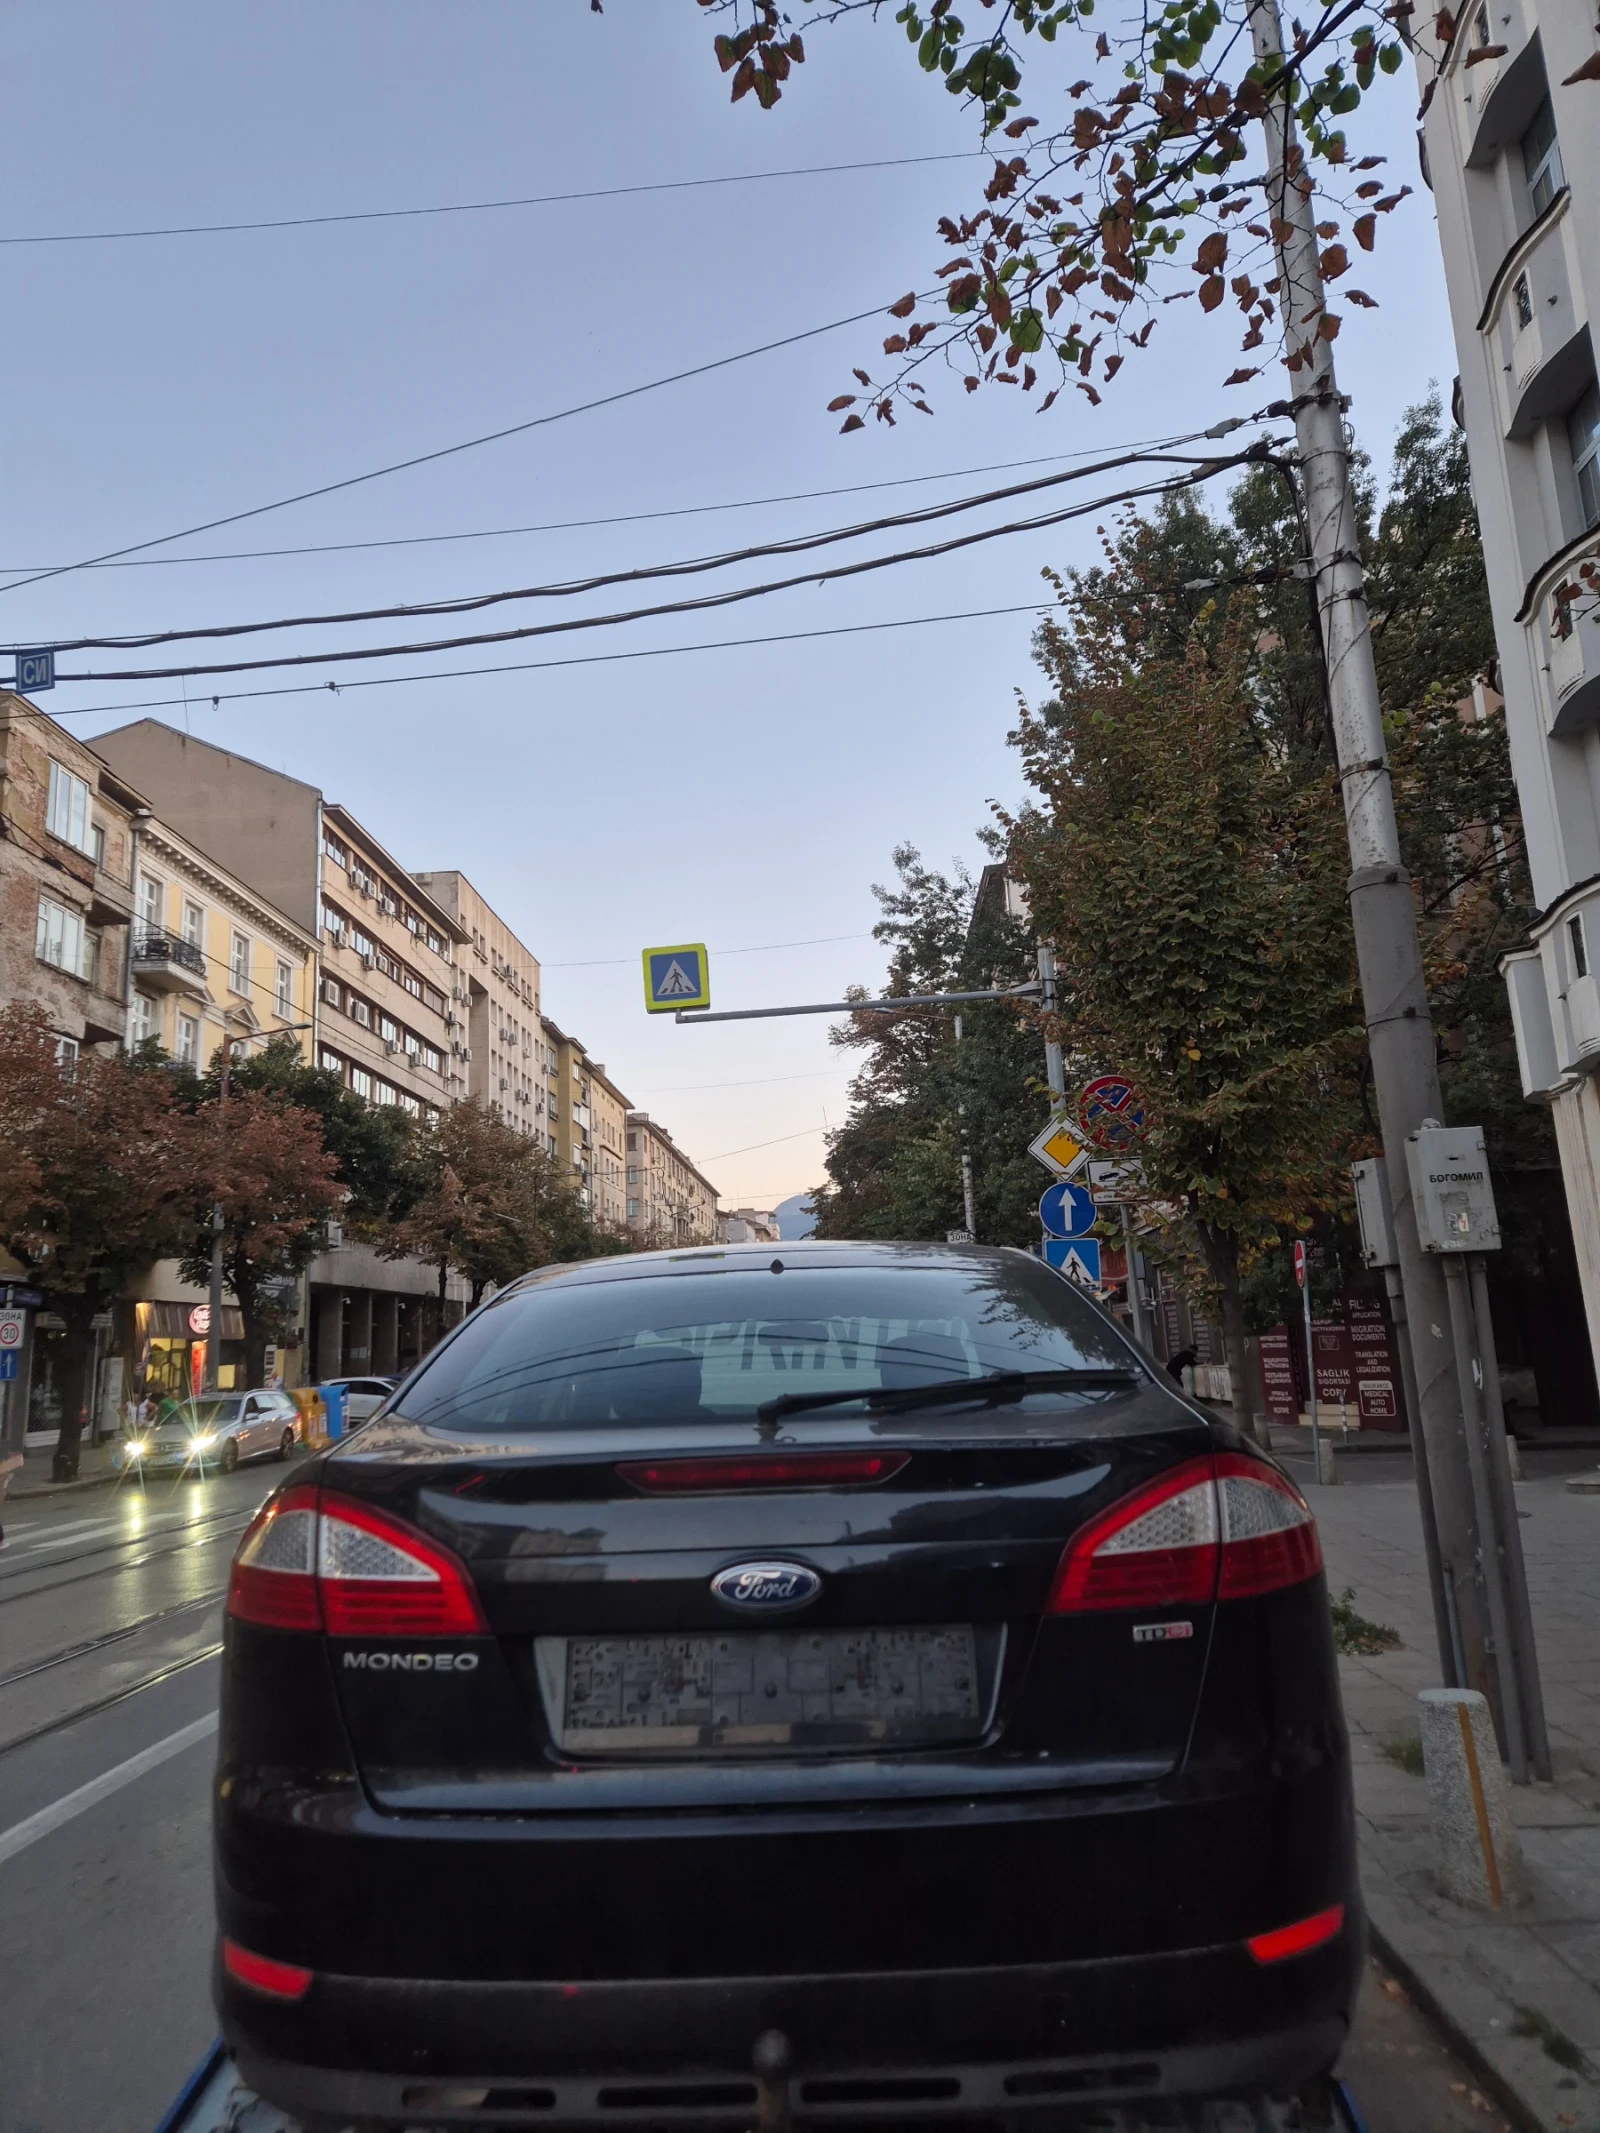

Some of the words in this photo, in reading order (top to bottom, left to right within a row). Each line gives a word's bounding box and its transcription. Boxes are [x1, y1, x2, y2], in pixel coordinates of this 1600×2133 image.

[23, 658, 46, 684] СИ
[1429, 1172, 1484, 1183] БОГОМИЛ
[1351, 1311, 1381, 1319] APPLICATION
[3, 1327, 16, 1340] 30
[1350, 1325, 1386, 1333] MIGRATION
[1352, 1333, 1387, 1341] DOCUMENTS
[1317, 1369, 1351, 1377] SAGLIK
[1364, 1390, 1390, 1398] MEDICAL
[734, 1570, 799, 1600] Ford
[343, 1652, 479, 1671] MONDEO
